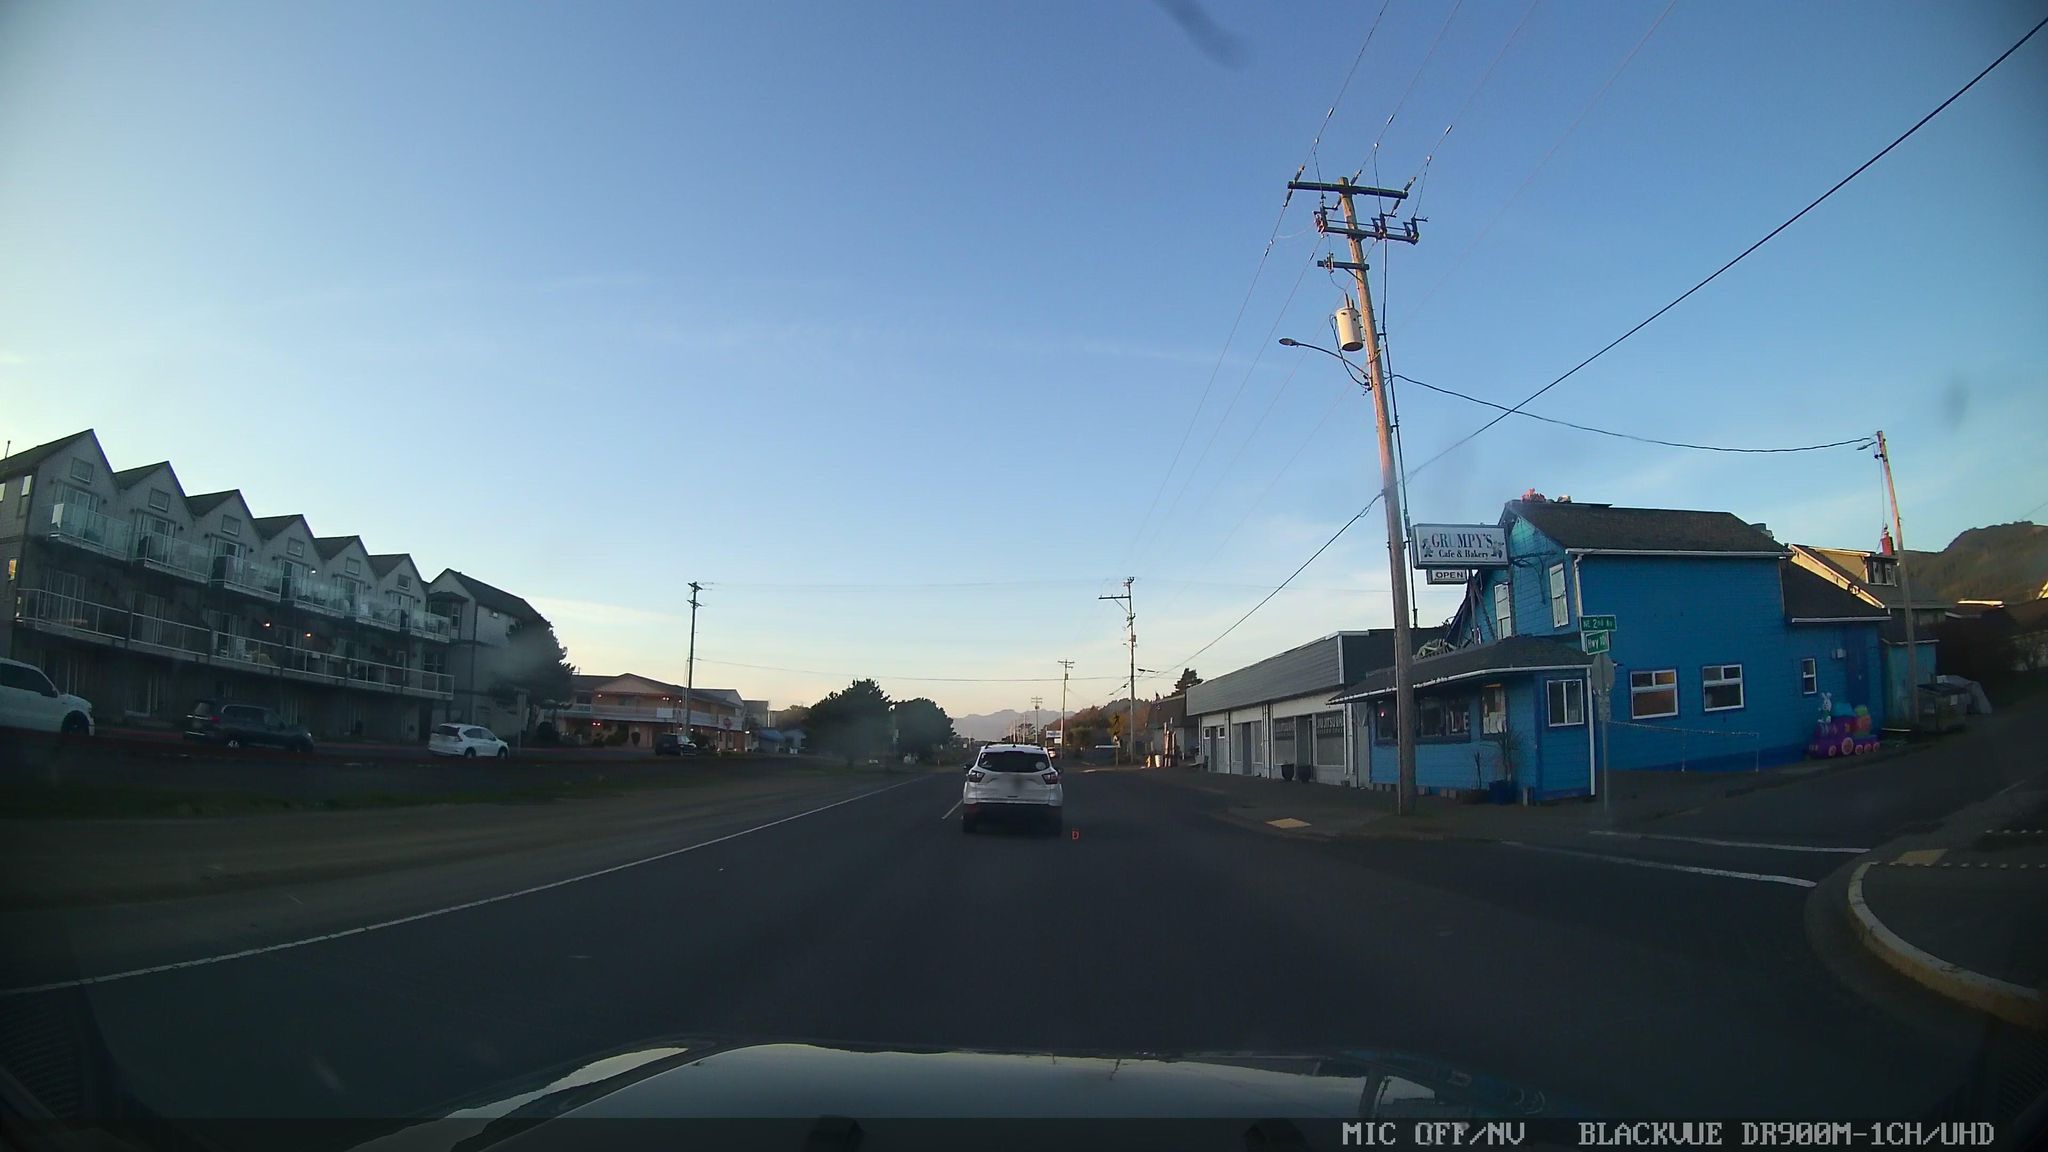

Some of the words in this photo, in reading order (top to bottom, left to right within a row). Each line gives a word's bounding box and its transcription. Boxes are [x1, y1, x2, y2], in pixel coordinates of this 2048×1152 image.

[1431, 533, 1493, 548] GRUMPY'S
[1457, 549, 1463, 558] &
[1465, 549, 1489, 560] Bakery
[1435, 571, 1464, 579] OPEN
